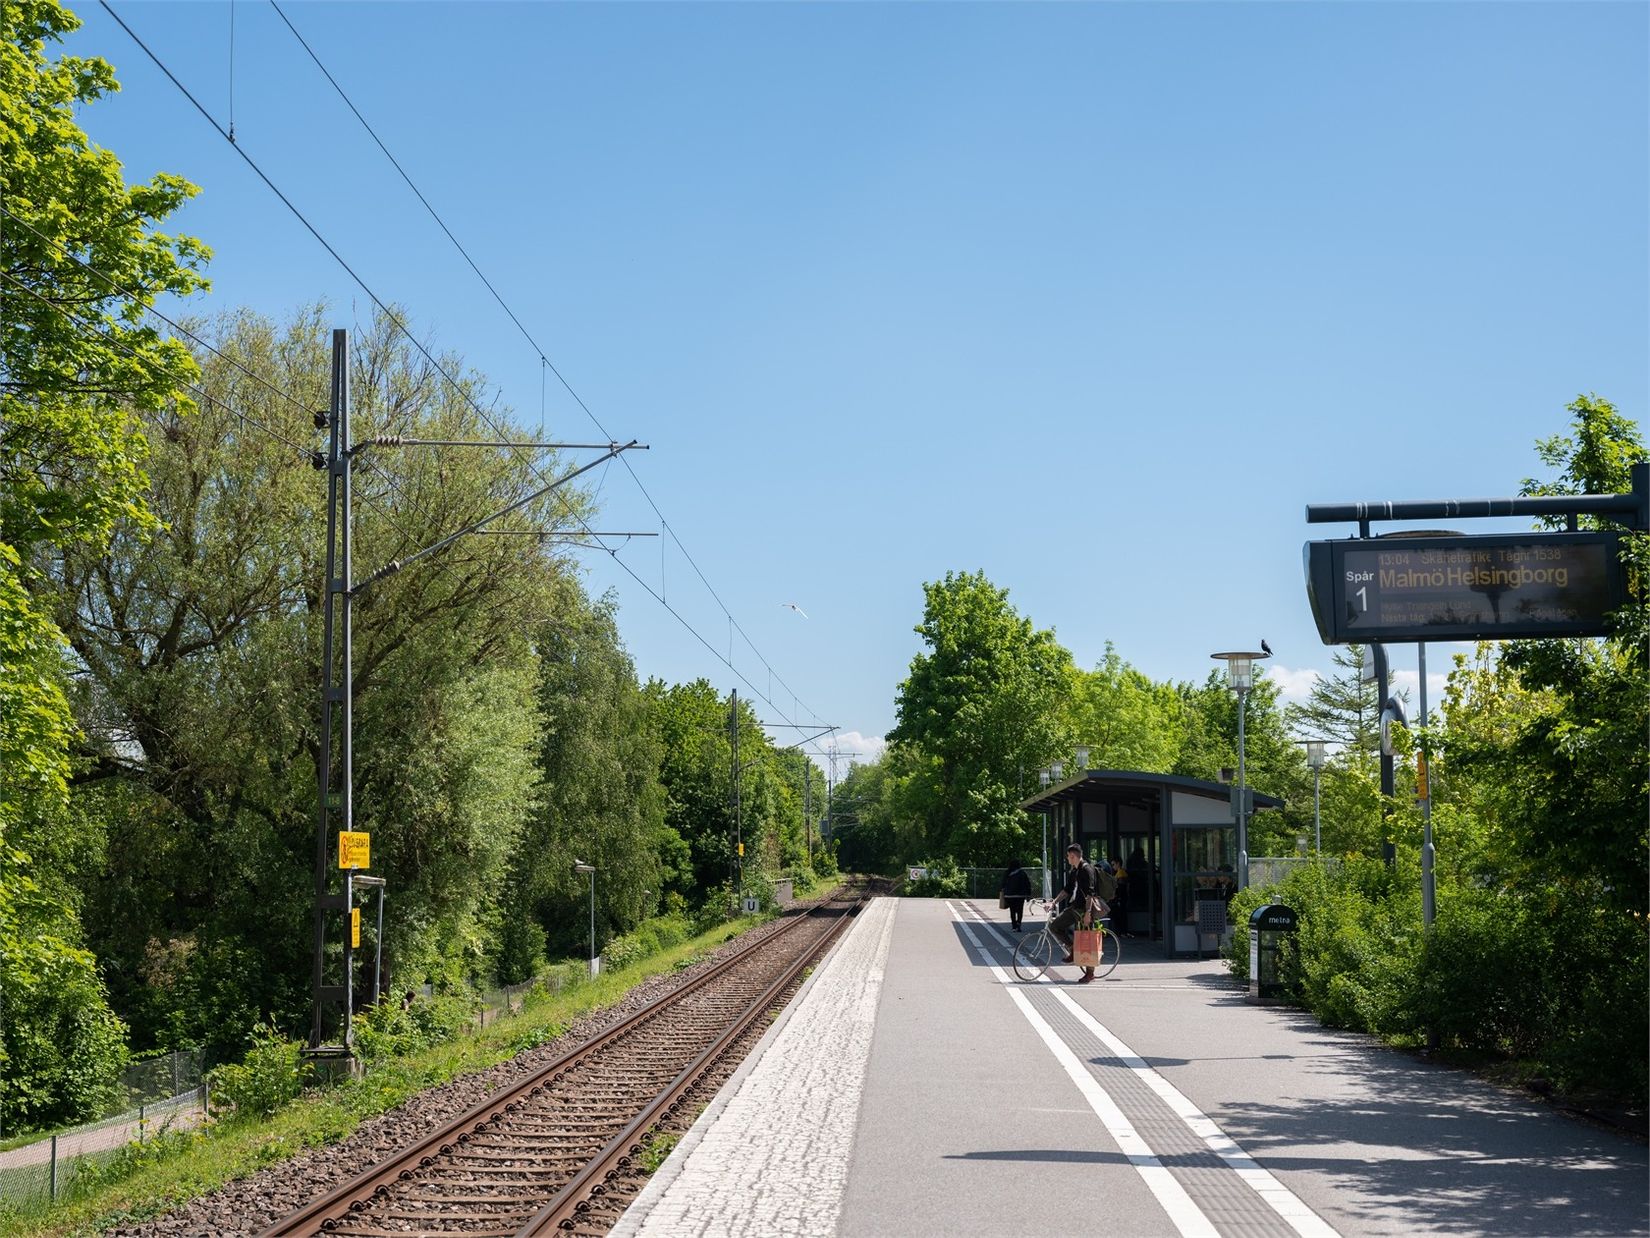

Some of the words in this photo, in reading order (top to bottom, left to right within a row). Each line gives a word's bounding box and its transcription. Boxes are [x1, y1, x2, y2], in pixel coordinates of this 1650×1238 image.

[1379, 553, 1409, 565] 13:04
[1499, 549, 1529, 563] Tågnr
[1534, 548, 1561, 560] 1538
[1346, 571, 1374, 583] Spår
[1380, 568, 1444, 588] Malmö
[1447, 564, 1568, 589] Helsingborg
[1356, 586, 1367, 611] 1
[748, 901, 755, 910] U
